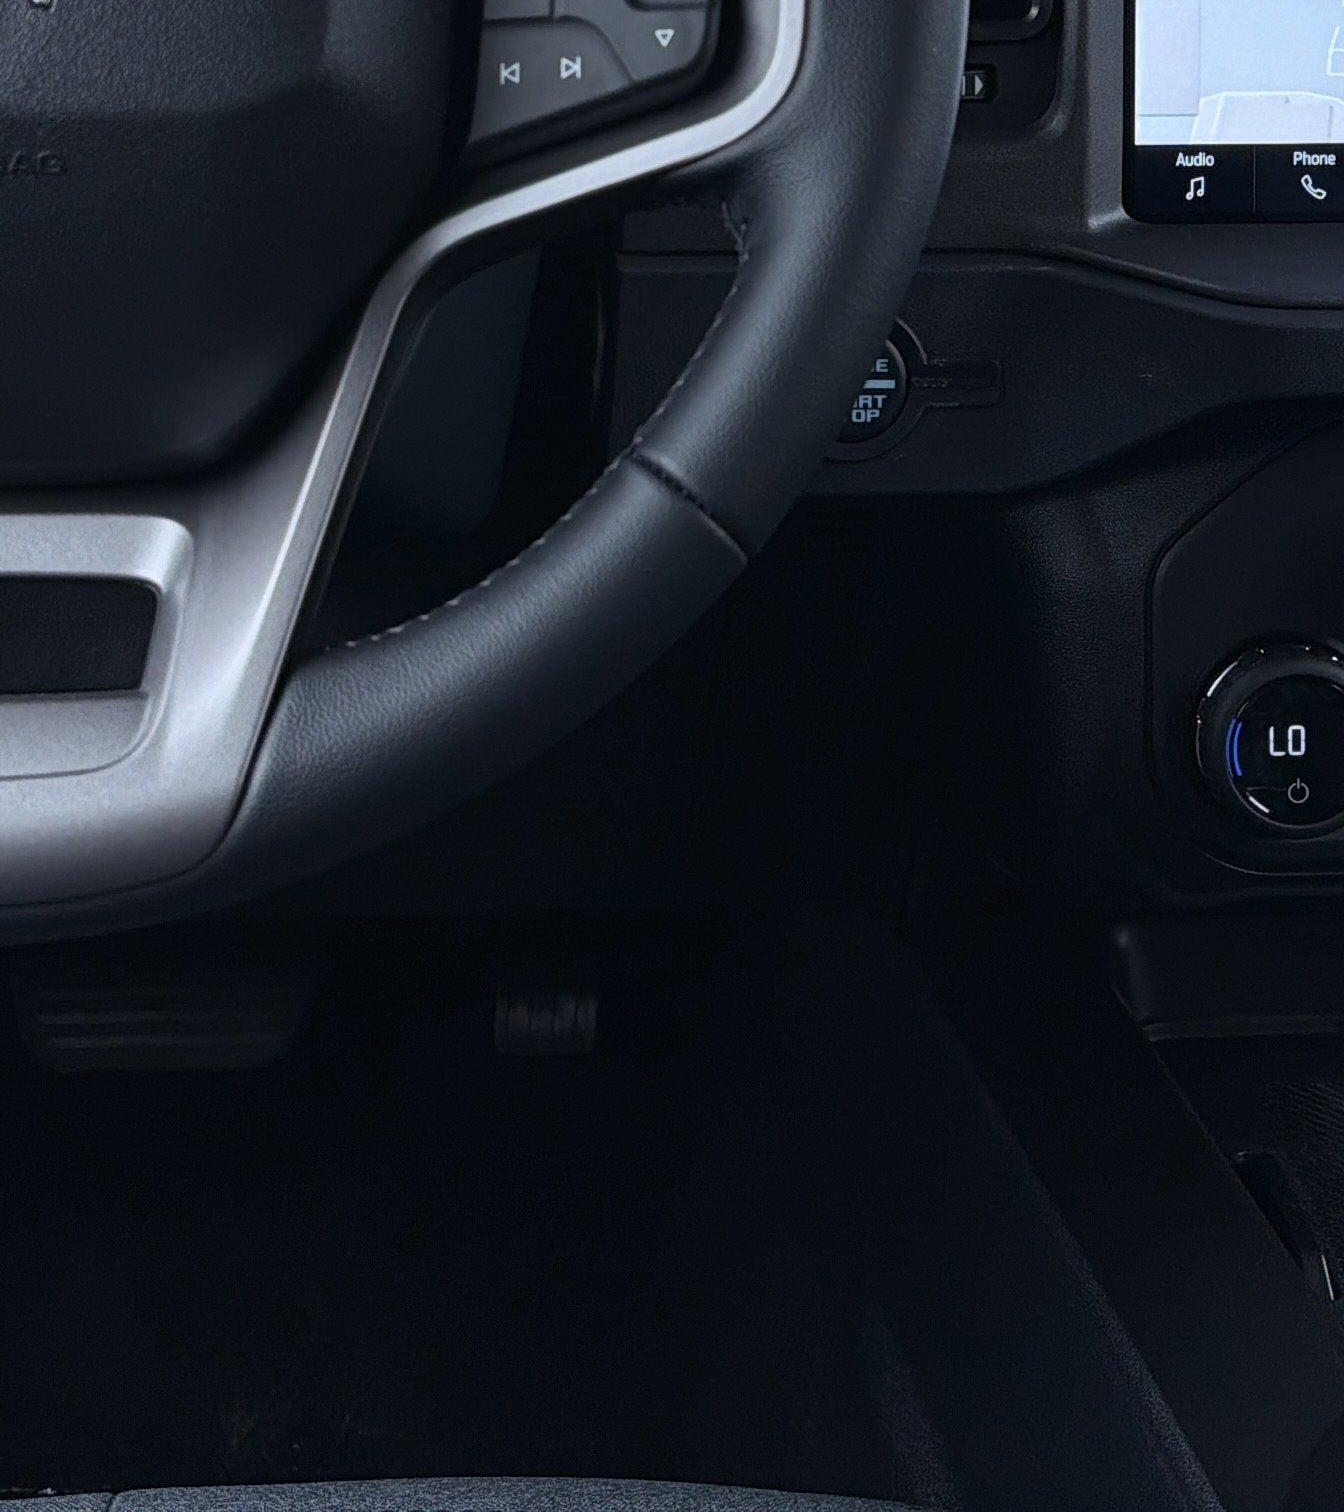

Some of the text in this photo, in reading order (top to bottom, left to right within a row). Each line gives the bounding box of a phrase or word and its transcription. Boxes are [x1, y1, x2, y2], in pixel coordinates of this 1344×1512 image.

[1176, 152, 1215, 167] Audio
[1293, 151, 1336, 166] Phone
[1269, 725, 1306, 757] LO
